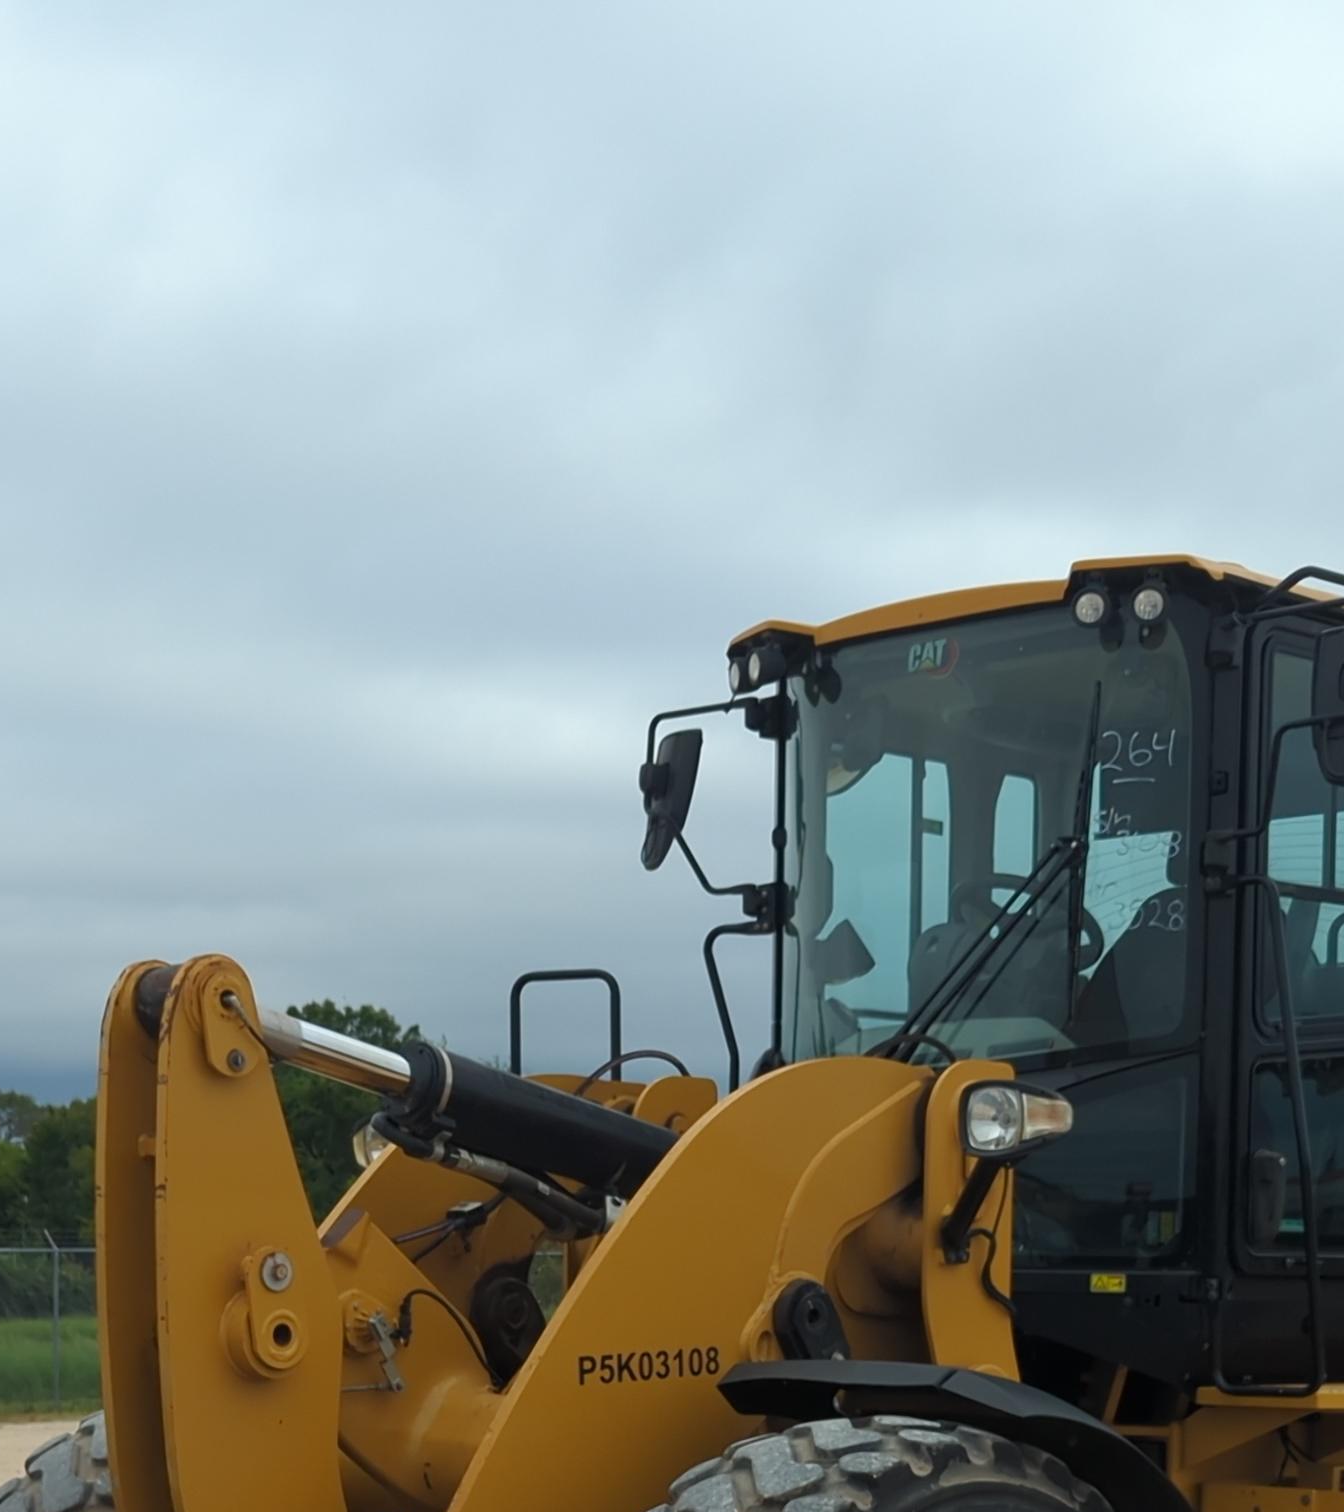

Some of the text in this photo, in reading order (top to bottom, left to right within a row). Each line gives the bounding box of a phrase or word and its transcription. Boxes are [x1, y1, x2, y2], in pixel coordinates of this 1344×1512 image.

[908, 638, 947, 672] CAT
[1102, 729, 1176, 771] 264
[578, 1346, 720, 1386] P5K03108
